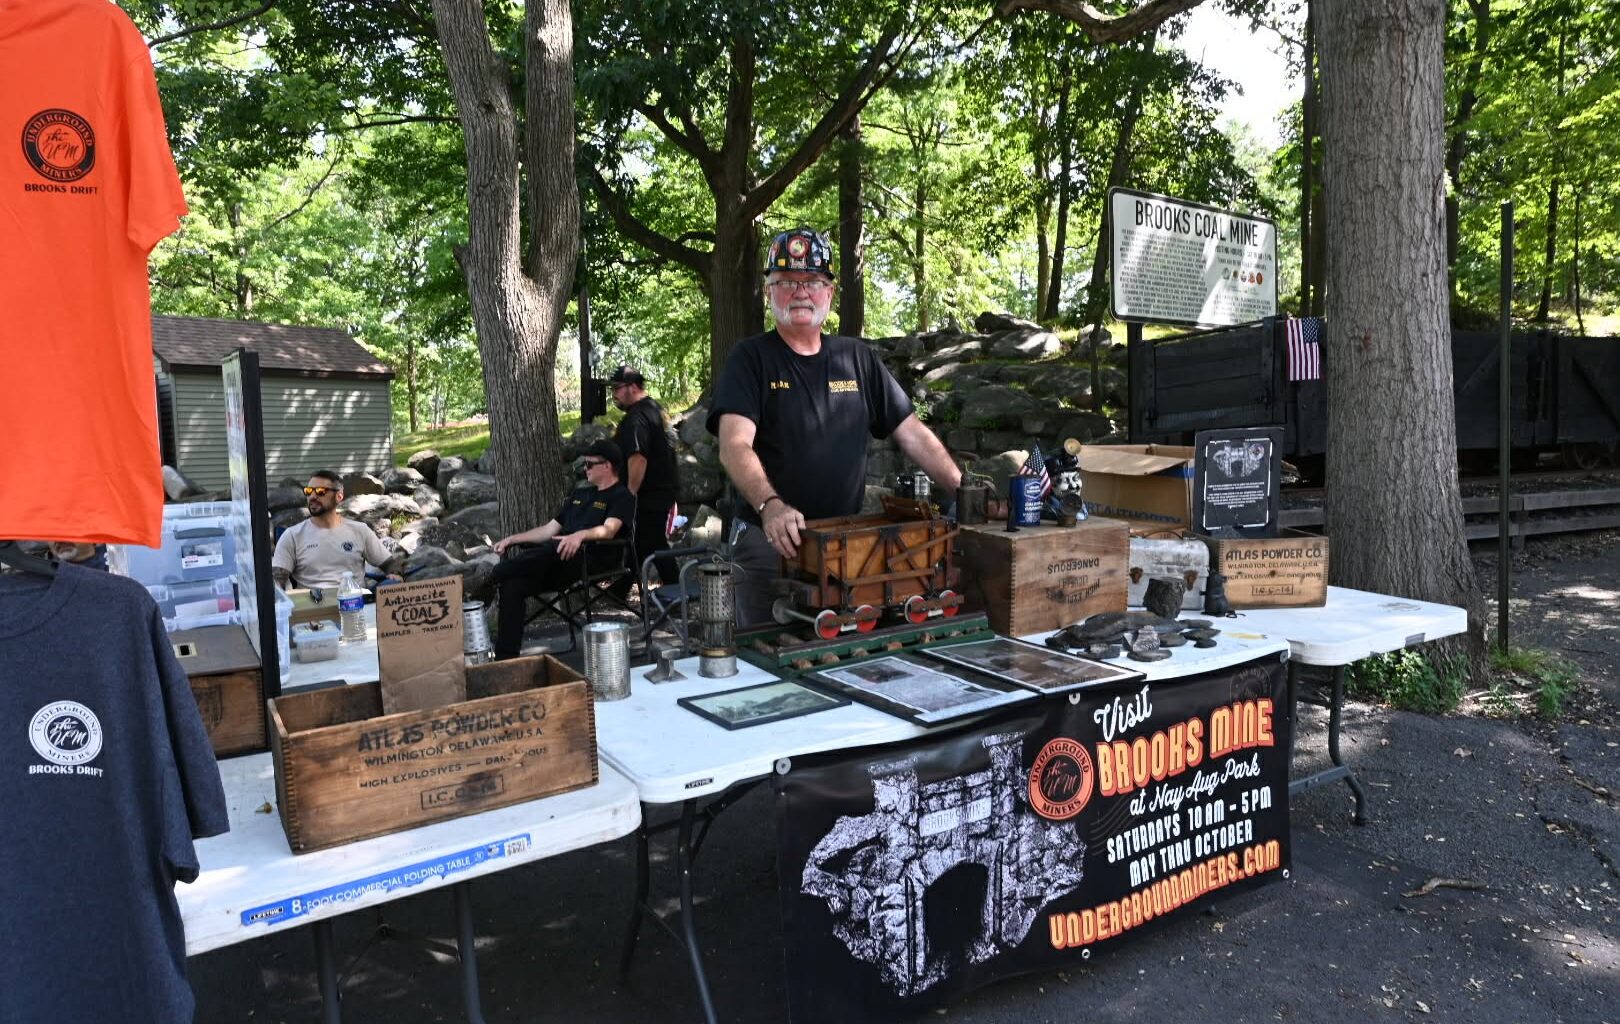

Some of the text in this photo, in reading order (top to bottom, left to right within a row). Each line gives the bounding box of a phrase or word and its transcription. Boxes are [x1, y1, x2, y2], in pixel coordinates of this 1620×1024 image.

[27, 113, 93, 146] UNDERGROUND
[41, 163, 82, 178] MINERS
[24, 183, 67, 193] BROOKS
[1135, 200, 1259, 247] BROOKS COAL MINE
[1047, 557, 1100, 575] DANGEROUS
[1226, 549, 1258, 561] ATLAS
[1261, 548, 1303, 560] POWDER
[379, 580, 456, 595] GENUINE PENNSYLVANIA
[383, 589, 446, 607] Anthracite
[401, 606, 438, 622] COAL
[422, 624, 439, 633] TAKE
[1094, 684, 1153, 742] Visit
[358, 723, 425, 752] ATLAS
[431, 711, 514, 740] POWDER
[47, 749, 91, 761] MINERS
[365, 747, 448, 767] WILMINGTON
[449, 732, 513, 752] DELAWARE
[1096, 697, 1274, 797] BROOKS MINE
[29, 765, 104, 777] BROOKS DRIFT
[359, 777, 389, 789] HIGH
[393, 763, 462, 784] EXPLOSIVES
[1031, 742, 1089, 783] UNDERGROUND
[1130, 752, 1260, 816] at Nay Aug Park
[1041, 799, 1081, 814] MINERS
[1106, 812, 1181, 864] SATURDAYS
[1188, 806, 1202, 831] 10
[1205, 799, 1225, 825] AM
[1241, 791, 1250, 814] 5
[1252, 785, 1272, 813] PM
[1129, 819, 1253, 888] MAY THRU OCTOBER
[336, 876, 402, 900] COMMERCIAL
[404, 863, 446, 884] FOLDING
[447, 855, 471, 870] TABLE
[1049, 839, 1281, 950] UNDERGROUNDMINERS.COM
